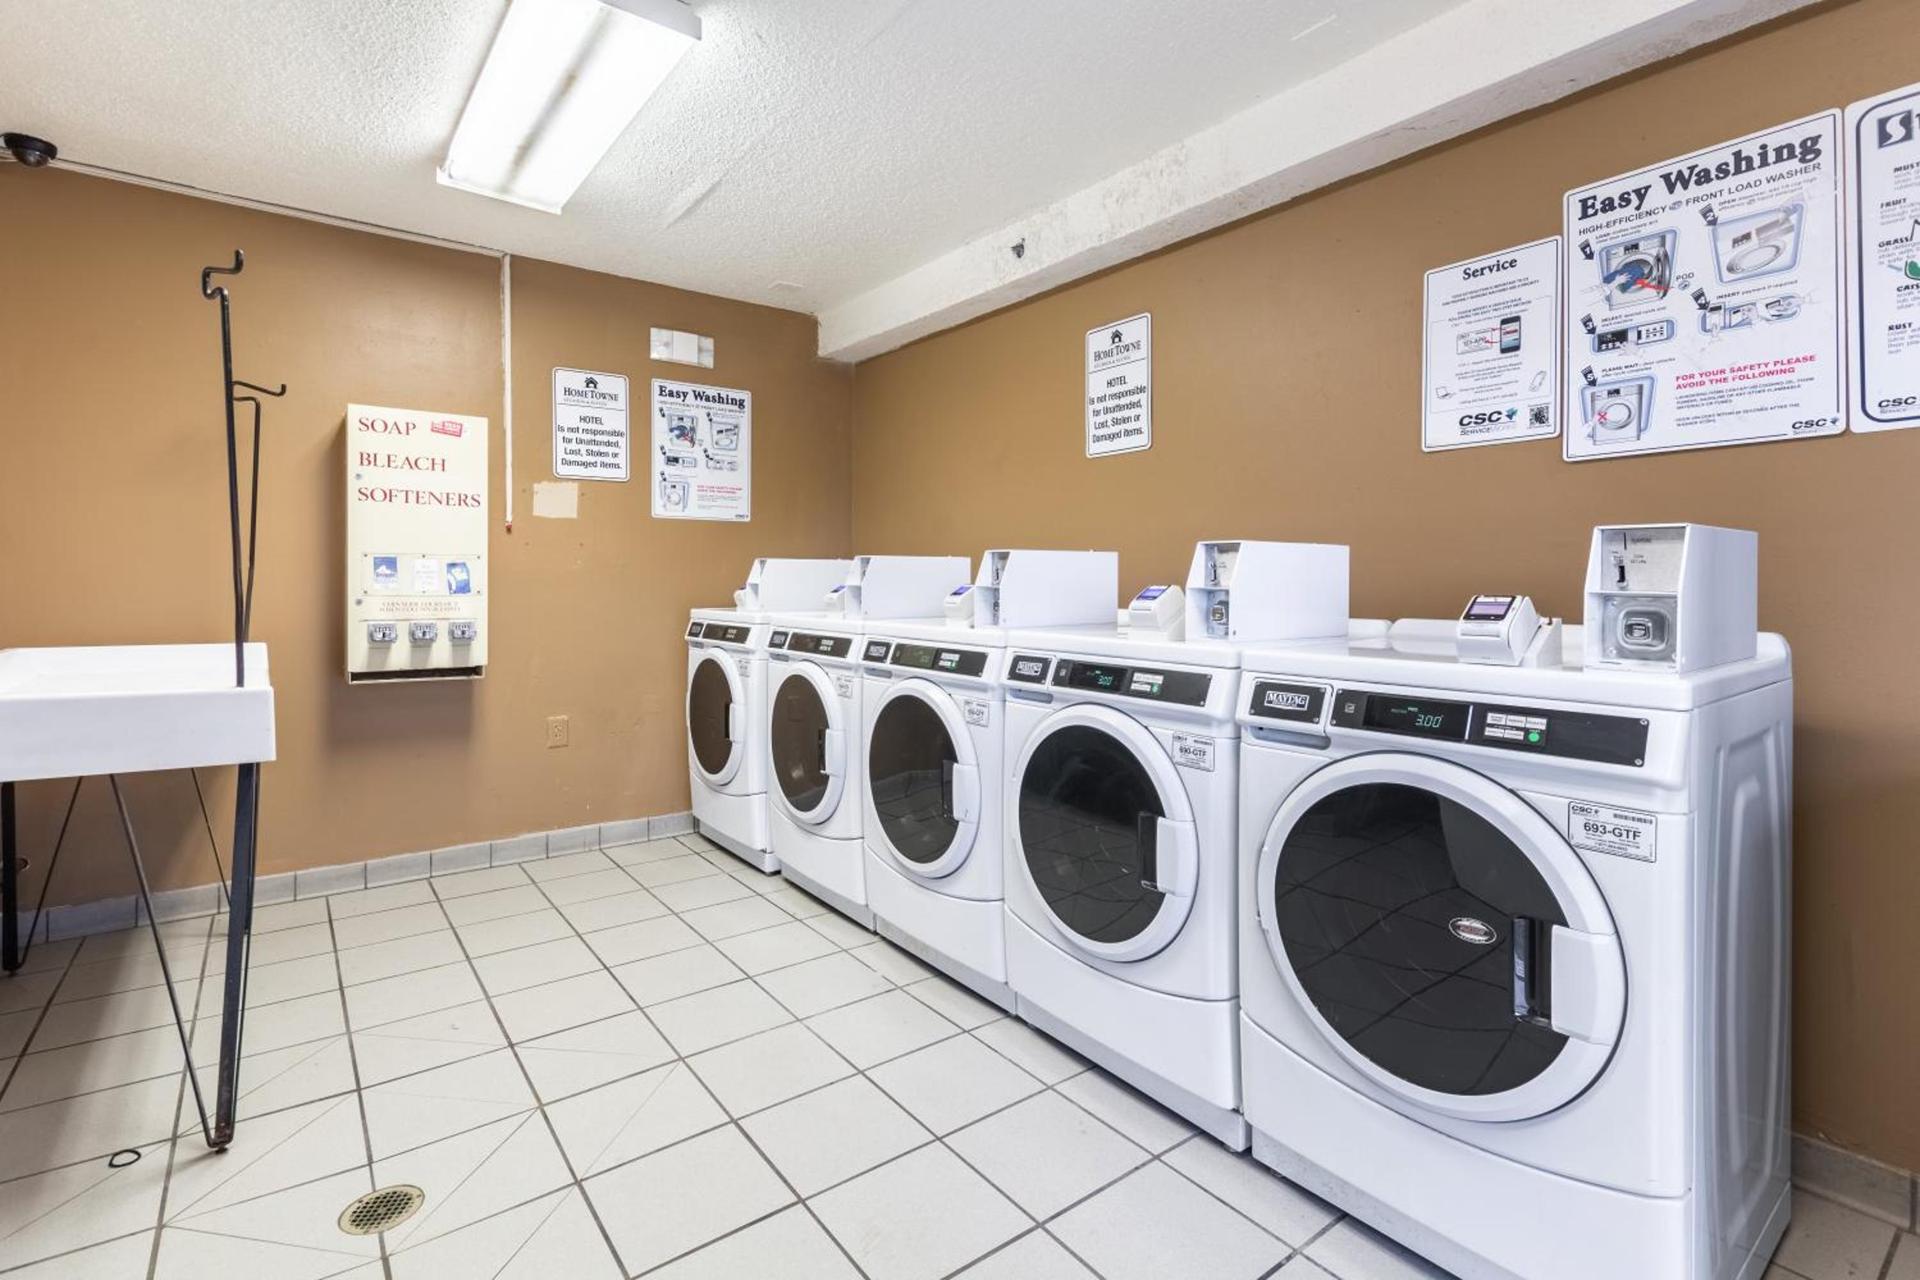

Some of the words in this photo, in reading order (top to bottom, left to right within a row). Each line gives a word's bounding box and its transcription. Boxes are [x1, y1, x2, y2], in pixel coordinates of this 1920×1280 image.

[1578, 184, 1651, 221] Easy
[1660, 133, 1822, 195] Washing
[1578, 205, 1668, 236] HIGH-EFFICIENCY
[1686, 189, 1725, 207] FRONT
[1728, 178, 1762, 196] LOAD
[1766, 163, 1821, 184] WASHER
[1462, 258, 1518, 281] Service
[1676, 272, 1694, 280] POD
[1676, 374, 1696, 382] FOR
[1699, 368, 1726, 378] YOUR
[1730, 362, 1770, 374] SAFETY
[1774, 354, 1816, 367] PLEASE
[1106, 376, 1127, 388] HOTEL
[1676, 381, 1706, 390] AVOID
[1732, 367, 1796, 382] FOLLOWING
[658, 385, 688, 402] Easy
[692, 390, 746, 410] Washing
[1097, 394, 1107, 403] not
[1108, 385, 1146, 401] responsible
[1878, 396, 1917, 408] CSC
[579, 415, 604, 425] HOTEL
[1093, 408, 1101, 418] for
[1459, 410, 1502, 426] CSC
[358, 416, 417, 437] SOAP
[1094, 420, 1110, 430] Lost,
[1111, 415, 1132, 428] Stolen
[1792, 418, 1827, 430] CSC
[582, 428, 625, 438] responsible
[1093, 430, 1122, 444] Damaged
[564, 448, 583, 458] Lost,
[359, 452, 446, 472] BLEACH
[561, 458, 598, 470] Damaged
[358, 486, 481, 508] SOFTENERS
[1266, 692, 1306, 706] MAYTAG
[1572, 805, 1593, 814] CSC
[1584, 822, 1642, 840] 693-GTF
